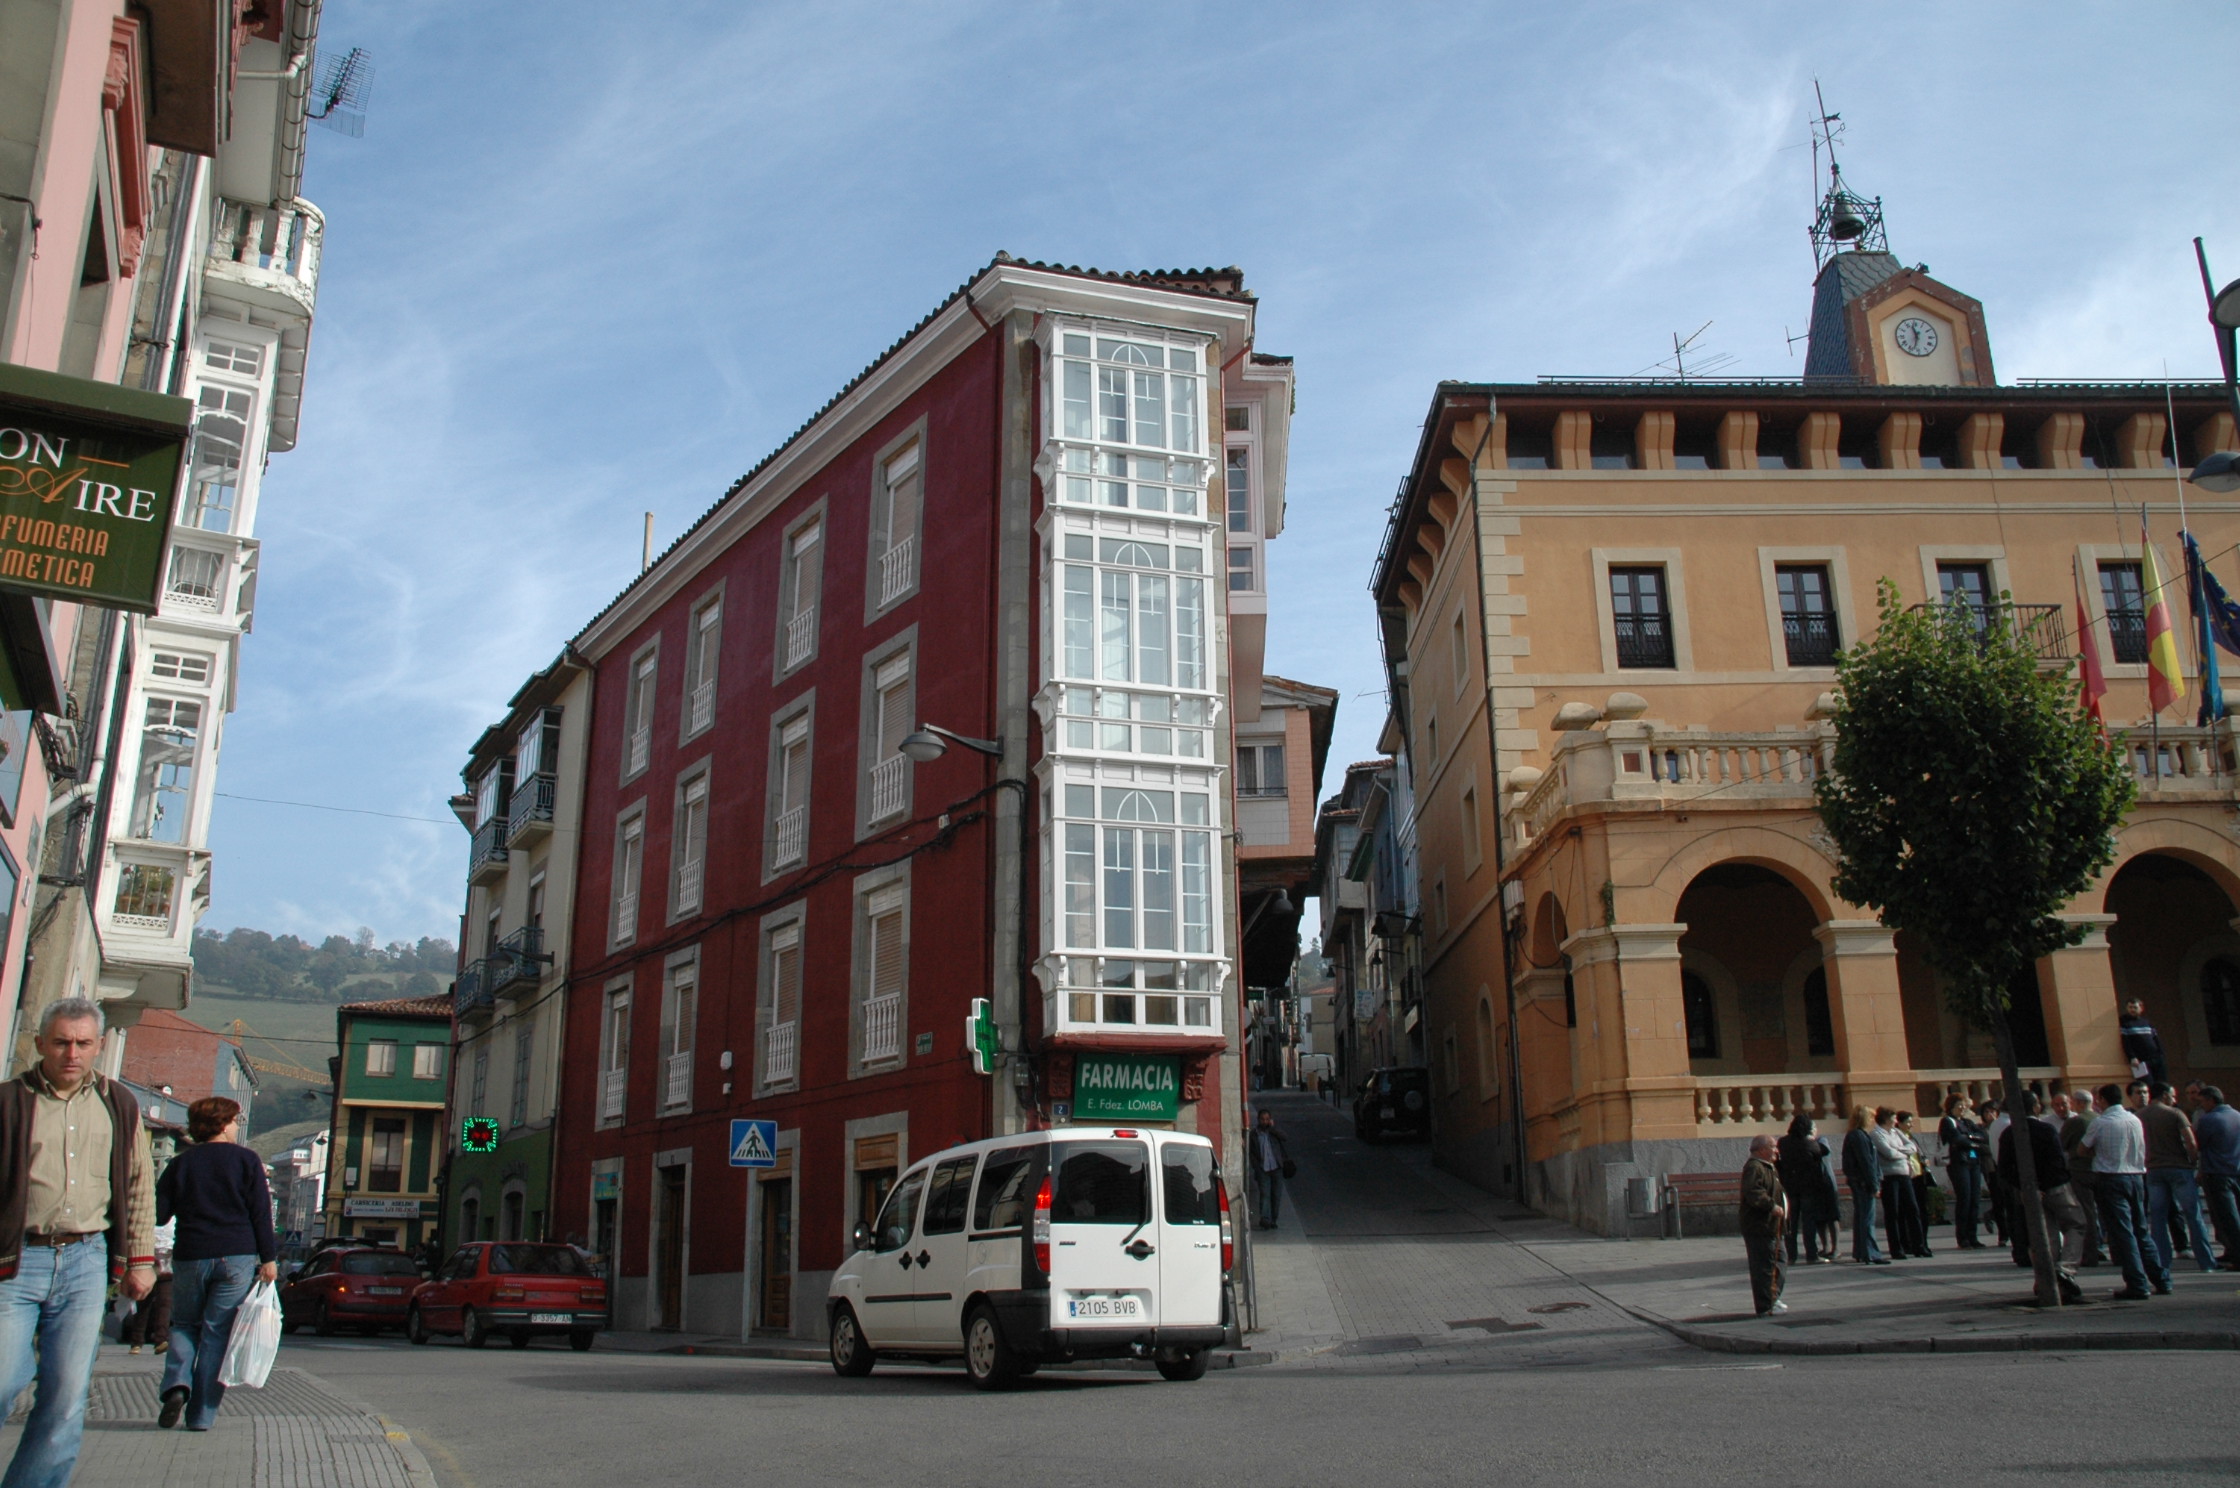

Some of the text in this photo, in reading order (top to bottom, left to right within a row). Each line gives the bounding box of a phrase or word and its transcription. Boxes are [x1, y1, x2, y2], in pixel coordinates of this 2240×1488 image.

[0, 513, 110, 557] FUMERIA
[0, 546, 96, 588] METICA
[1081, 1062, 1173, 1091] FARMACIA
[1057, 1105, 1064, 1115] 2
[1087, 1098, 1164, 1112] E. Fdez. LOMBA
[1079, 1301, 1136, 1315] 2105 BVB
